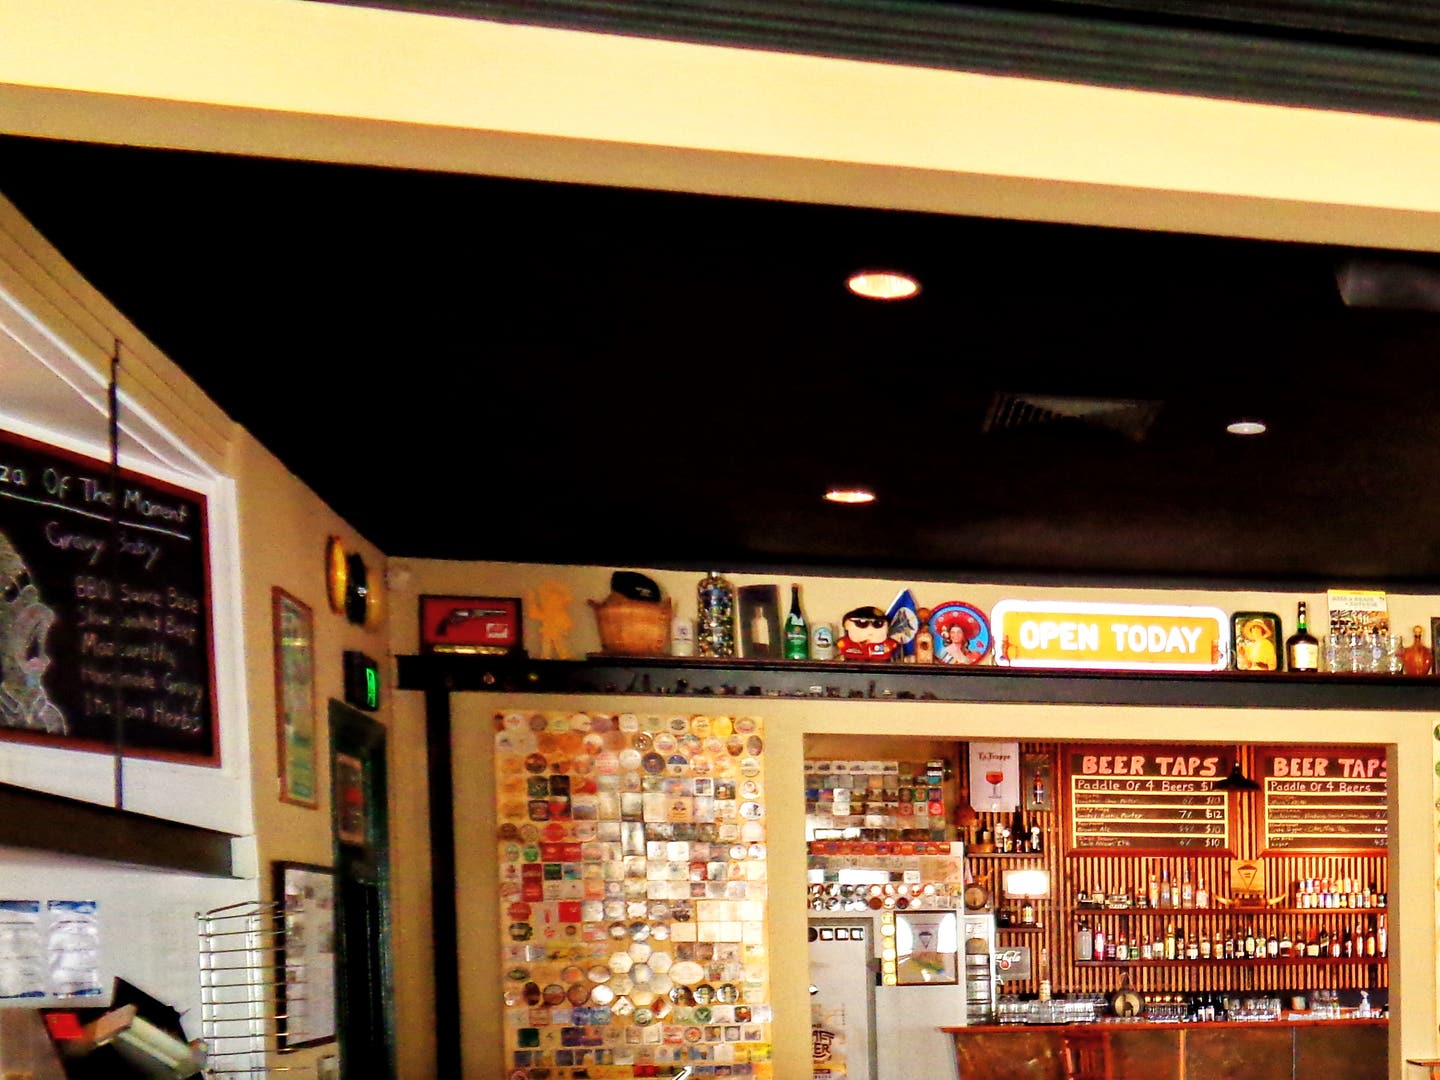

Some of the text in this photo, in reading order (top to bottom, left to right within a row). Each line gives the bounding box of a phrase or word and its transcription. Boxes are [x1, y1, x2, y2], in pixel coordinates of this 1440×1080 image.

[123, 489, 188, 522] Moment
[1019, 620, 1202, 654] OPEN TODAY
[1082, 755, 1219, 776] BEER TAPS
[1273, 757, 1329, 777] BEER
[1077, 780, 1121, 791] Paddle
[1126, 781, 1140, 791] Of
[1145, 780, 1155, 791] 4
[1162, 781, 1194, 792] Beers
[1270, 781, 1306, 792] Paddle
[1326, 782, 1334, 792] 4
[1339, 782, 1371, 793] Beers
[1205, 808, 1223, 819] $12
[1205, 838, 1220, 847] $10
